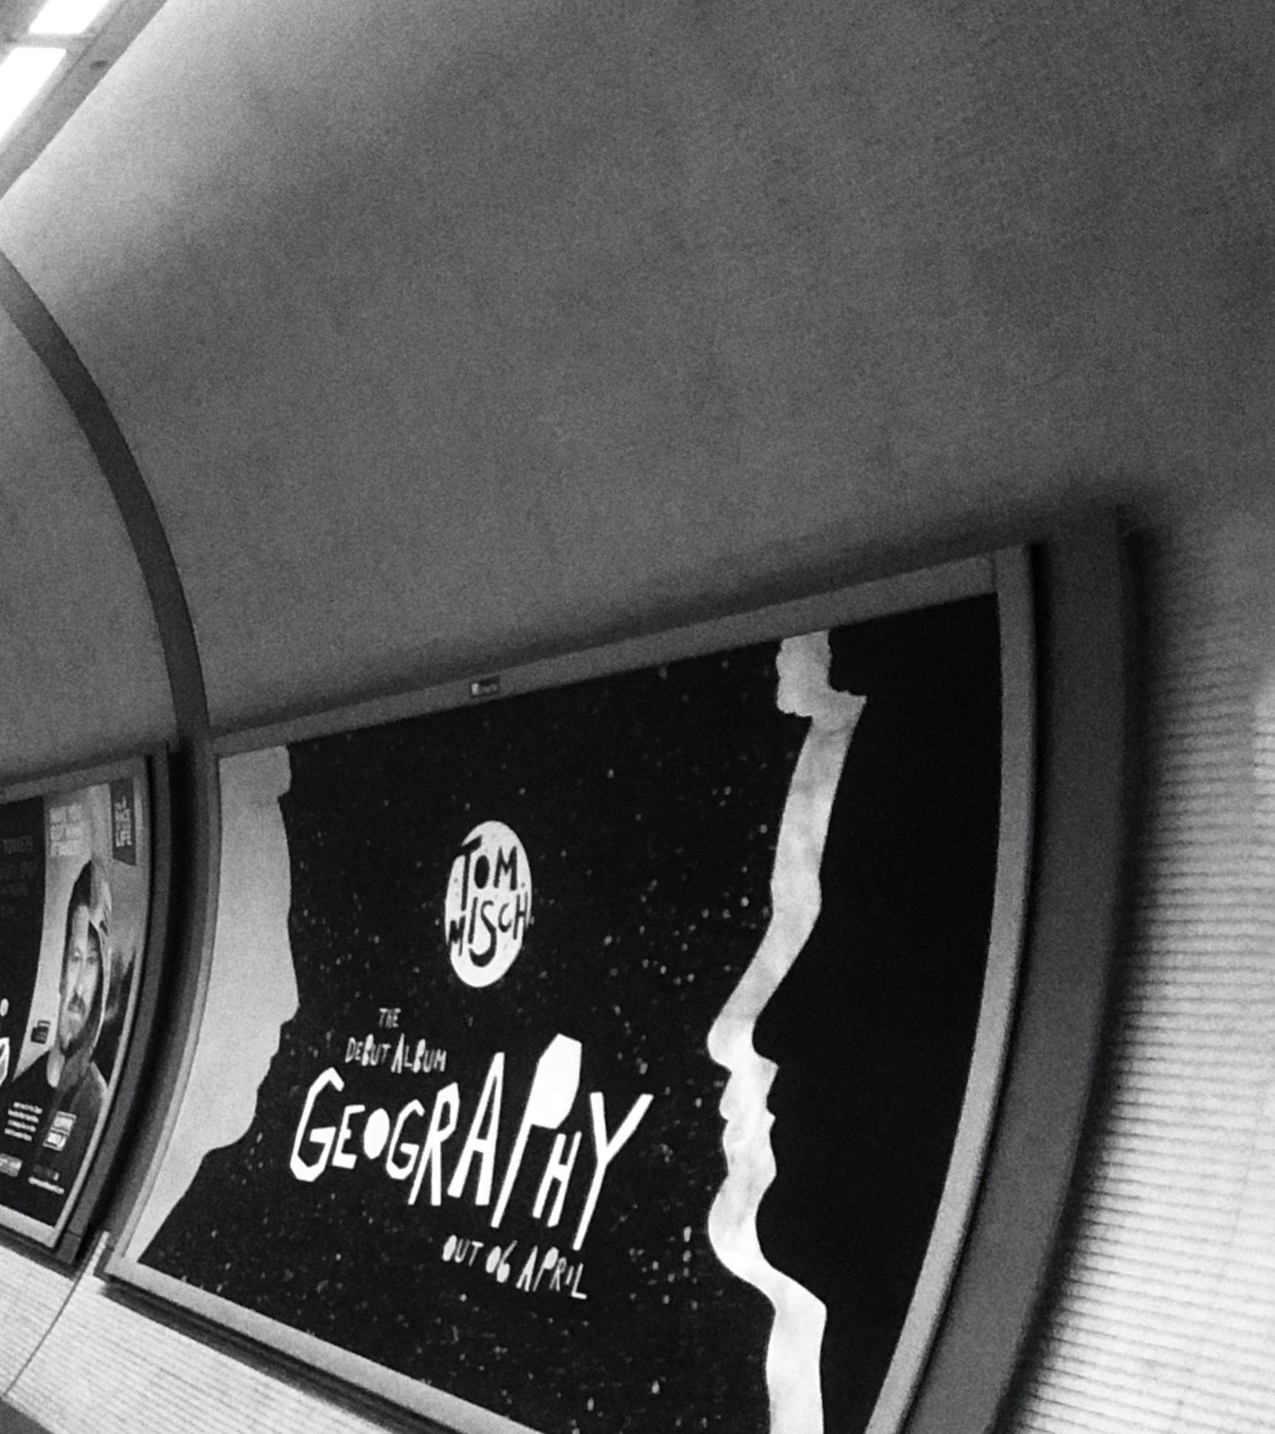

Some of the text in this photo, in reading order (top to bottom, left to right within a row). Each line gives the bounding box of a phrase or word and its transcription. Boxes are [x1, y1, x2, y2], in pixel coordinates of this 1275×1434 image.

[458, 835, 518, 911] TOM
[449, 891, 528, 968] MISCH
[379, 1007, 401, 1029] THE
[345, 1033, 447, 1074] DEBUT ALBUM
[289, 1033, 654, 1251] GEOGRAPHY
[442, 1235, 588, 1300] OUT 06 APRIL
